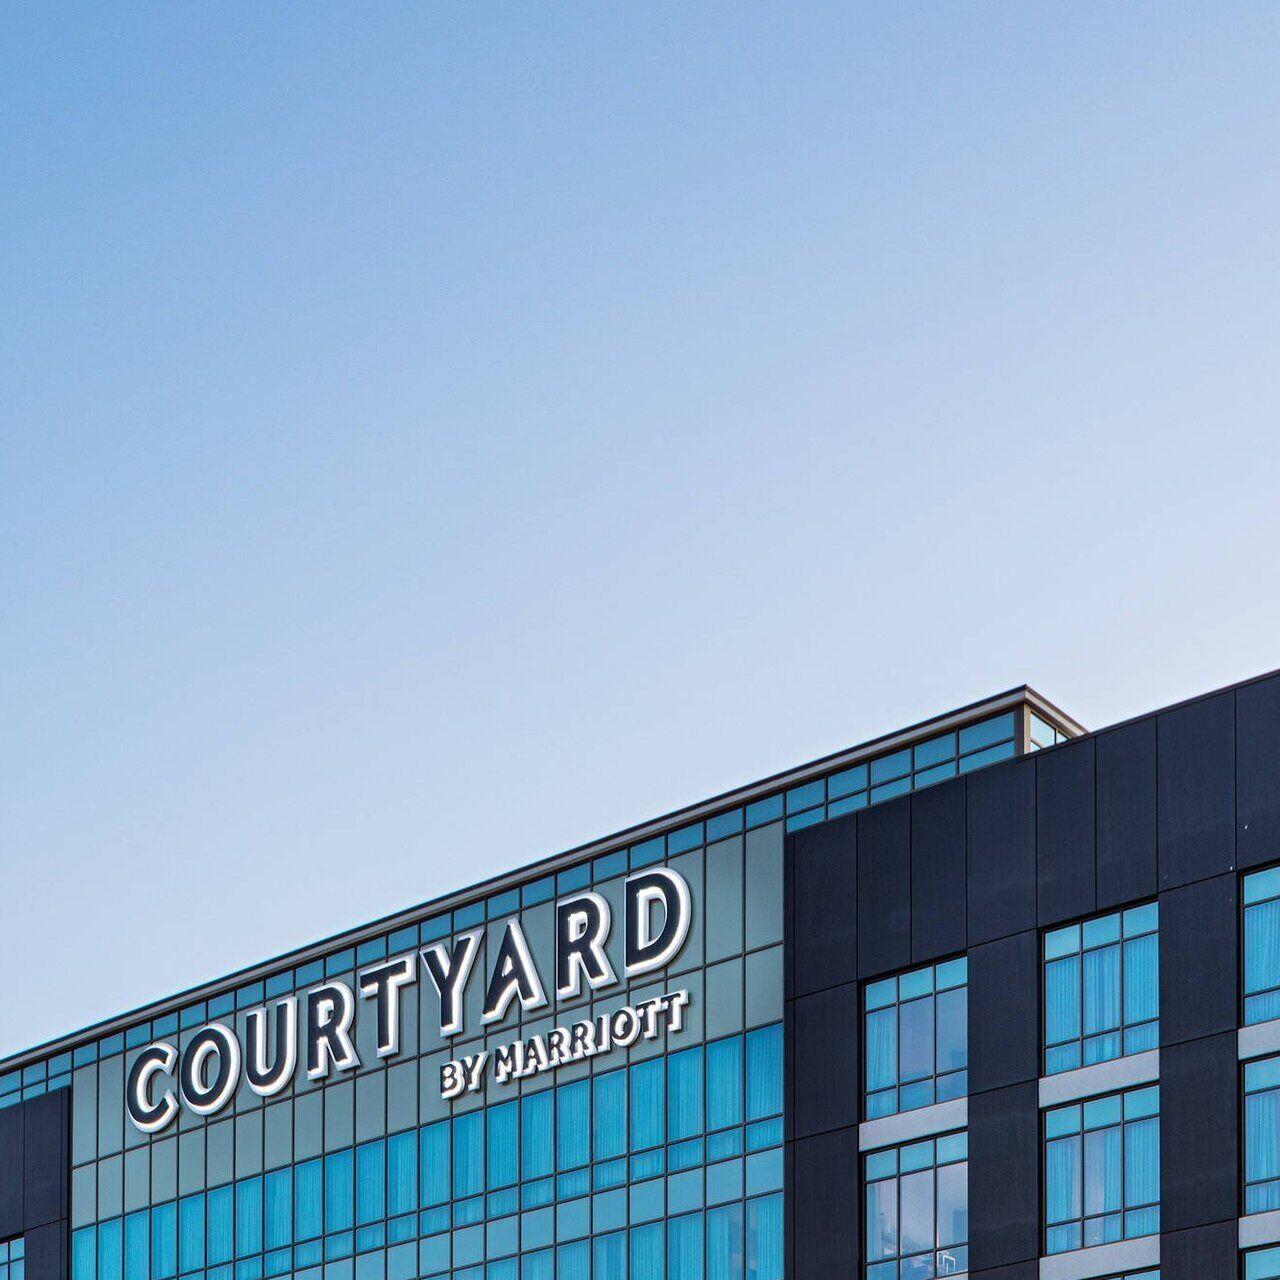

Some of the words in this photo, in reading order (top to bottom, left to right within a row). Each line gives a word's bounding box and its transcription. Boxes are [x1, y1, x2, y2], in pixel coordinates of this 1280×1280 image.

[126, 867, 692, 1134] COURTYARD
[440, 1050, 488, 1099] BY
[494, 989, 689, 1083] MARRIOTT
